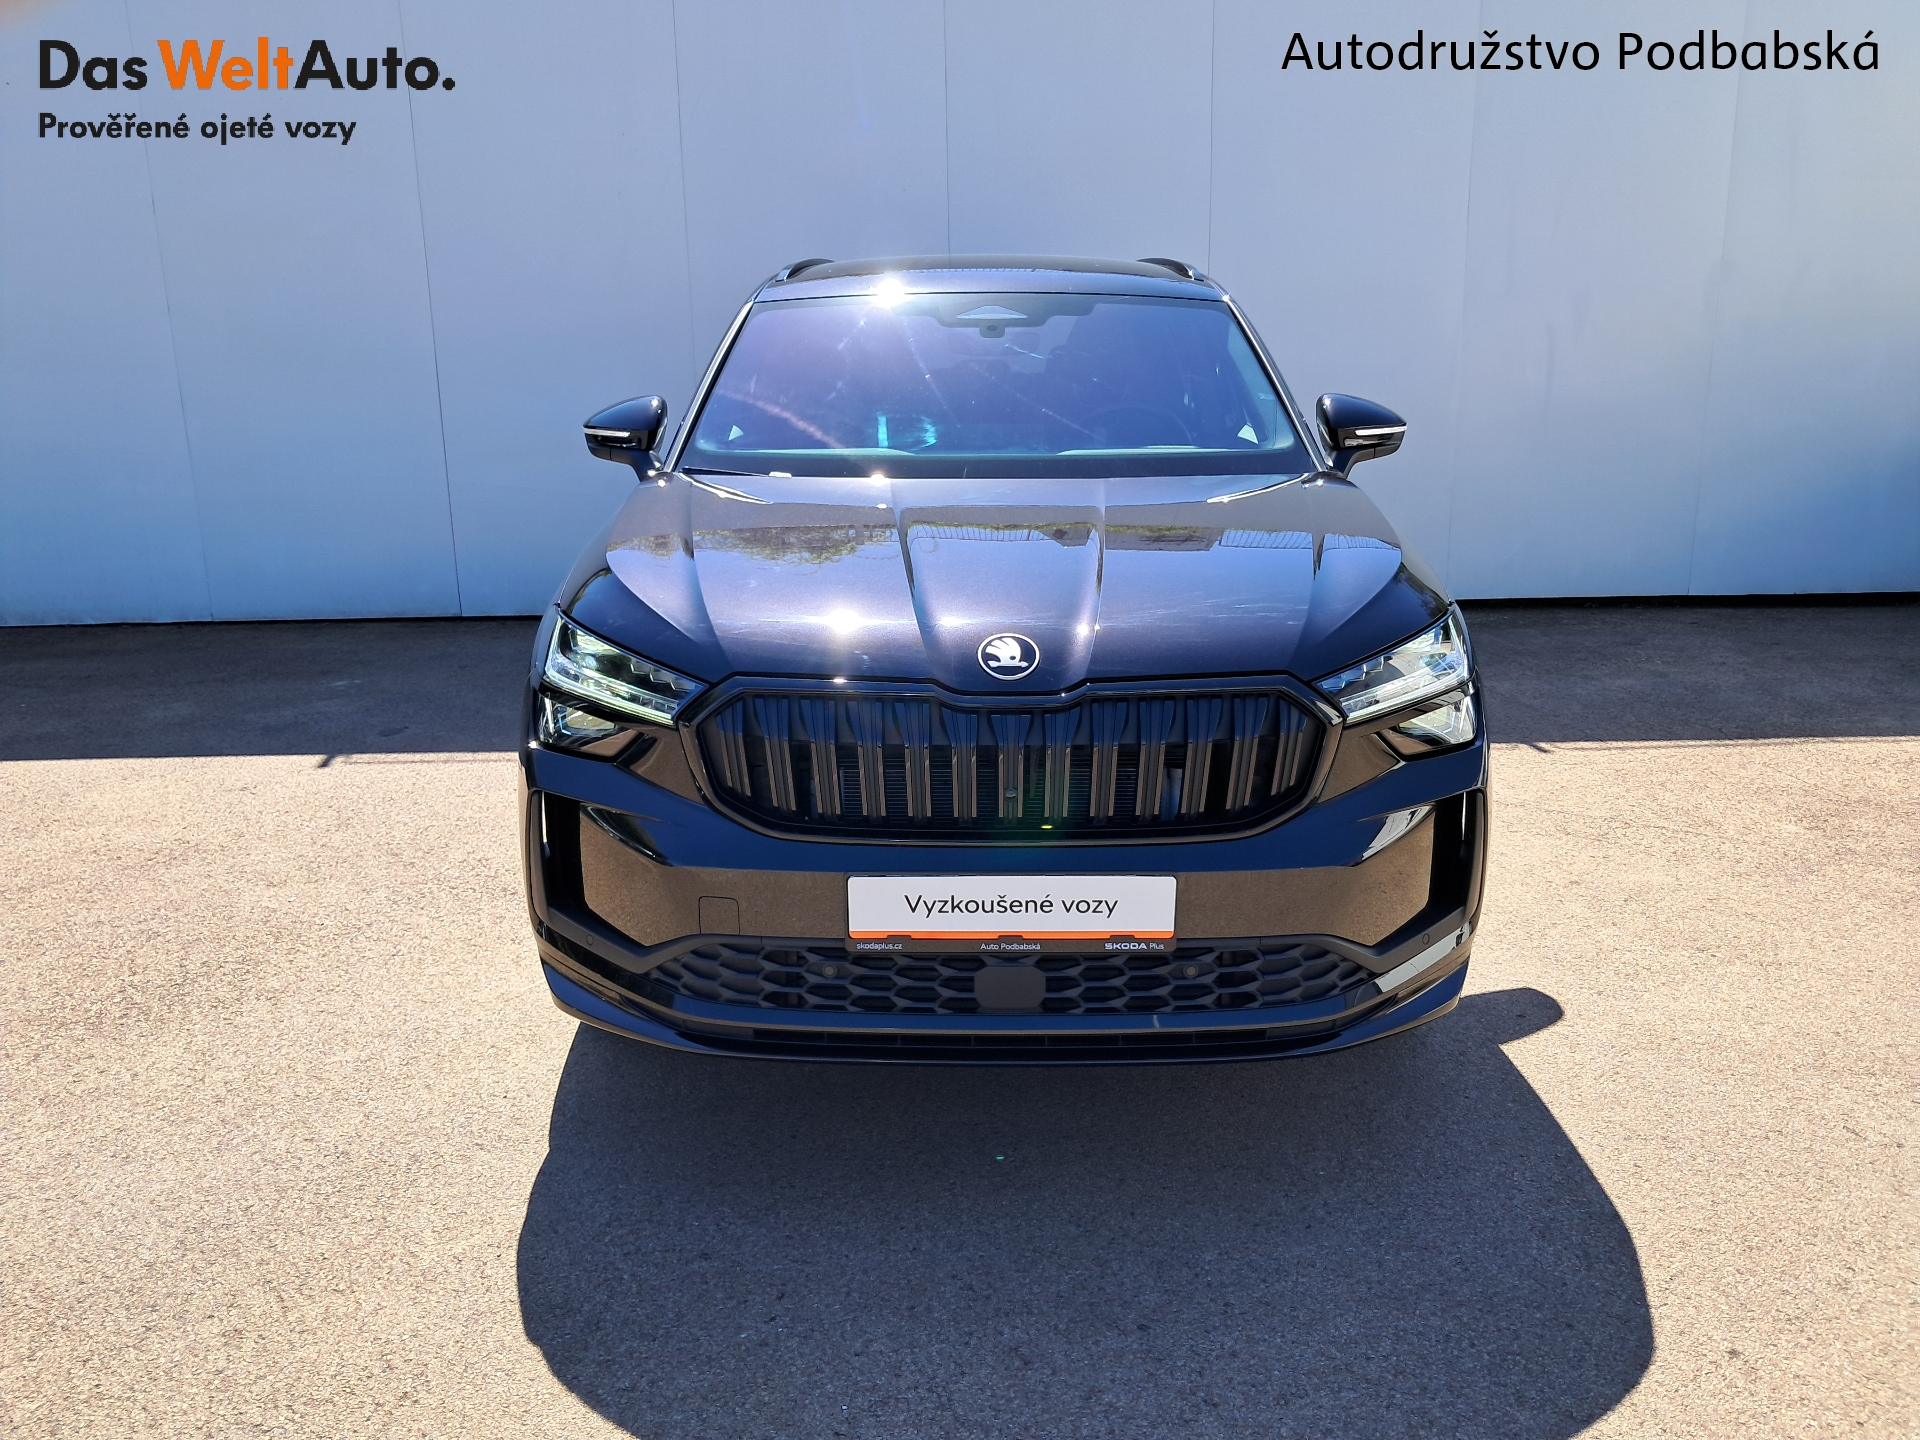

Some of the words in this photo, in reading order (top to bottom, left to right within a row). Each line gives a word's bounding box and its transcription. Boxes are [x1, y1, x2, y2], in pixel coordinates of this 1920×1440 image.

[904, 894, 1054, 919] Vyzkoušené
[1061, 899, 1119, 919] vozy
[856, 942, 903, 951] skodaplus.cz
[980, 942, 999, 950] Auto
[1000, 942, 1041, 950] Podbabská
[1149, 942, 1165, 950] Plus
